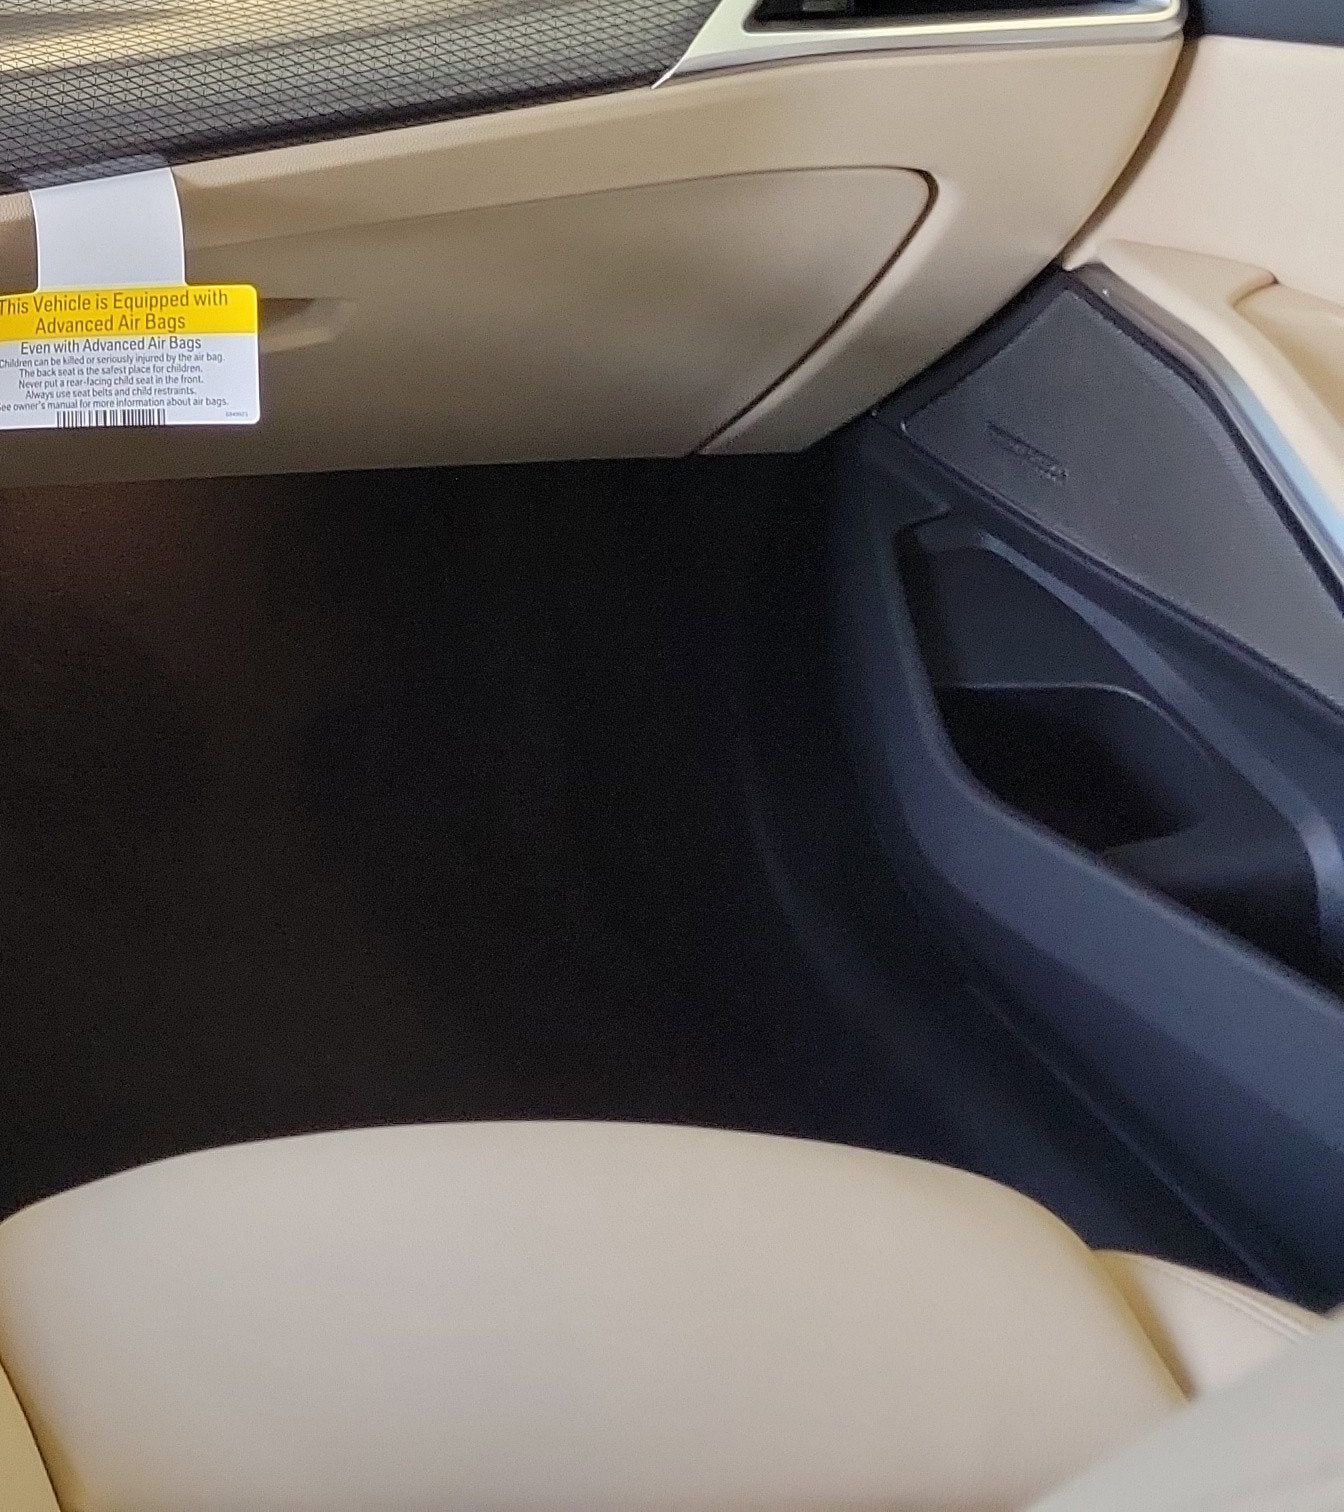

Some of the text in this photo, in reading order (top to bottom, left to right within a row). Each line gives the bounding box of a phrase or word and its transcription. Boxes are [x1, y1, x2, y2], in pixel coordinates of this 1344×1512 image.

[33, 294, 91, 313] Vehicle
[95, 293, 108, 310] is
[113, 290, 189, 311] Equipped
[194, 289, 229, 306] with
[35, 313, 186, 335] Advanced Air Bags
[21, 335, 202, 355] Even with Advanced Air Bags
[34, 358, 49, 367] can
[50, 356, 61, 366] be
[86, 356, 96, 365] or
[97, 354, 133, 365] seriously
[135, 353, 165, 365] injured
[166, 353, 176, 364] by
[178, 353, 192, 362] the
[194, 353, 205, 361] air
[206, 352, 225, 363] bag.
[19, 368, 35, 378] The
[36, 367, 57, 377] back
[58, 367, 76, 376] seat
[77, 366, 84, 376] is
[86, 366, 100, 375] the
[128, 364, 151, 375] place
[152, 364, 164, 373] for
[166, 363, 203, 373] children.
[18, 379, 42, 389] Never
[44, 378, 58, 390] put
[66, 377, 112, 388] rear-facing
[114, 375, 134, 385] child
[135, 376, 154, 384] seat
[155, 375, 164, 384] in
[165, 375, 179, 384] the
[180, 374, 204, 384] front.
[25, 390, 54, 401] Always
[55, 390, 71, 398] use
[114, 387, 130, 396] and
[132, 386, 152, 396] child
[13, 400, 46, 411] owner's
[47, 399, 78, 409] manual
[79, 398, 91, 408] for
[93, 400, 115, 408] more
[116, 397, 165, 408] information
[166, 397, 191, 407] about
[193, 397, 204, 406] air
[205, 396, 229, 407] bags.
